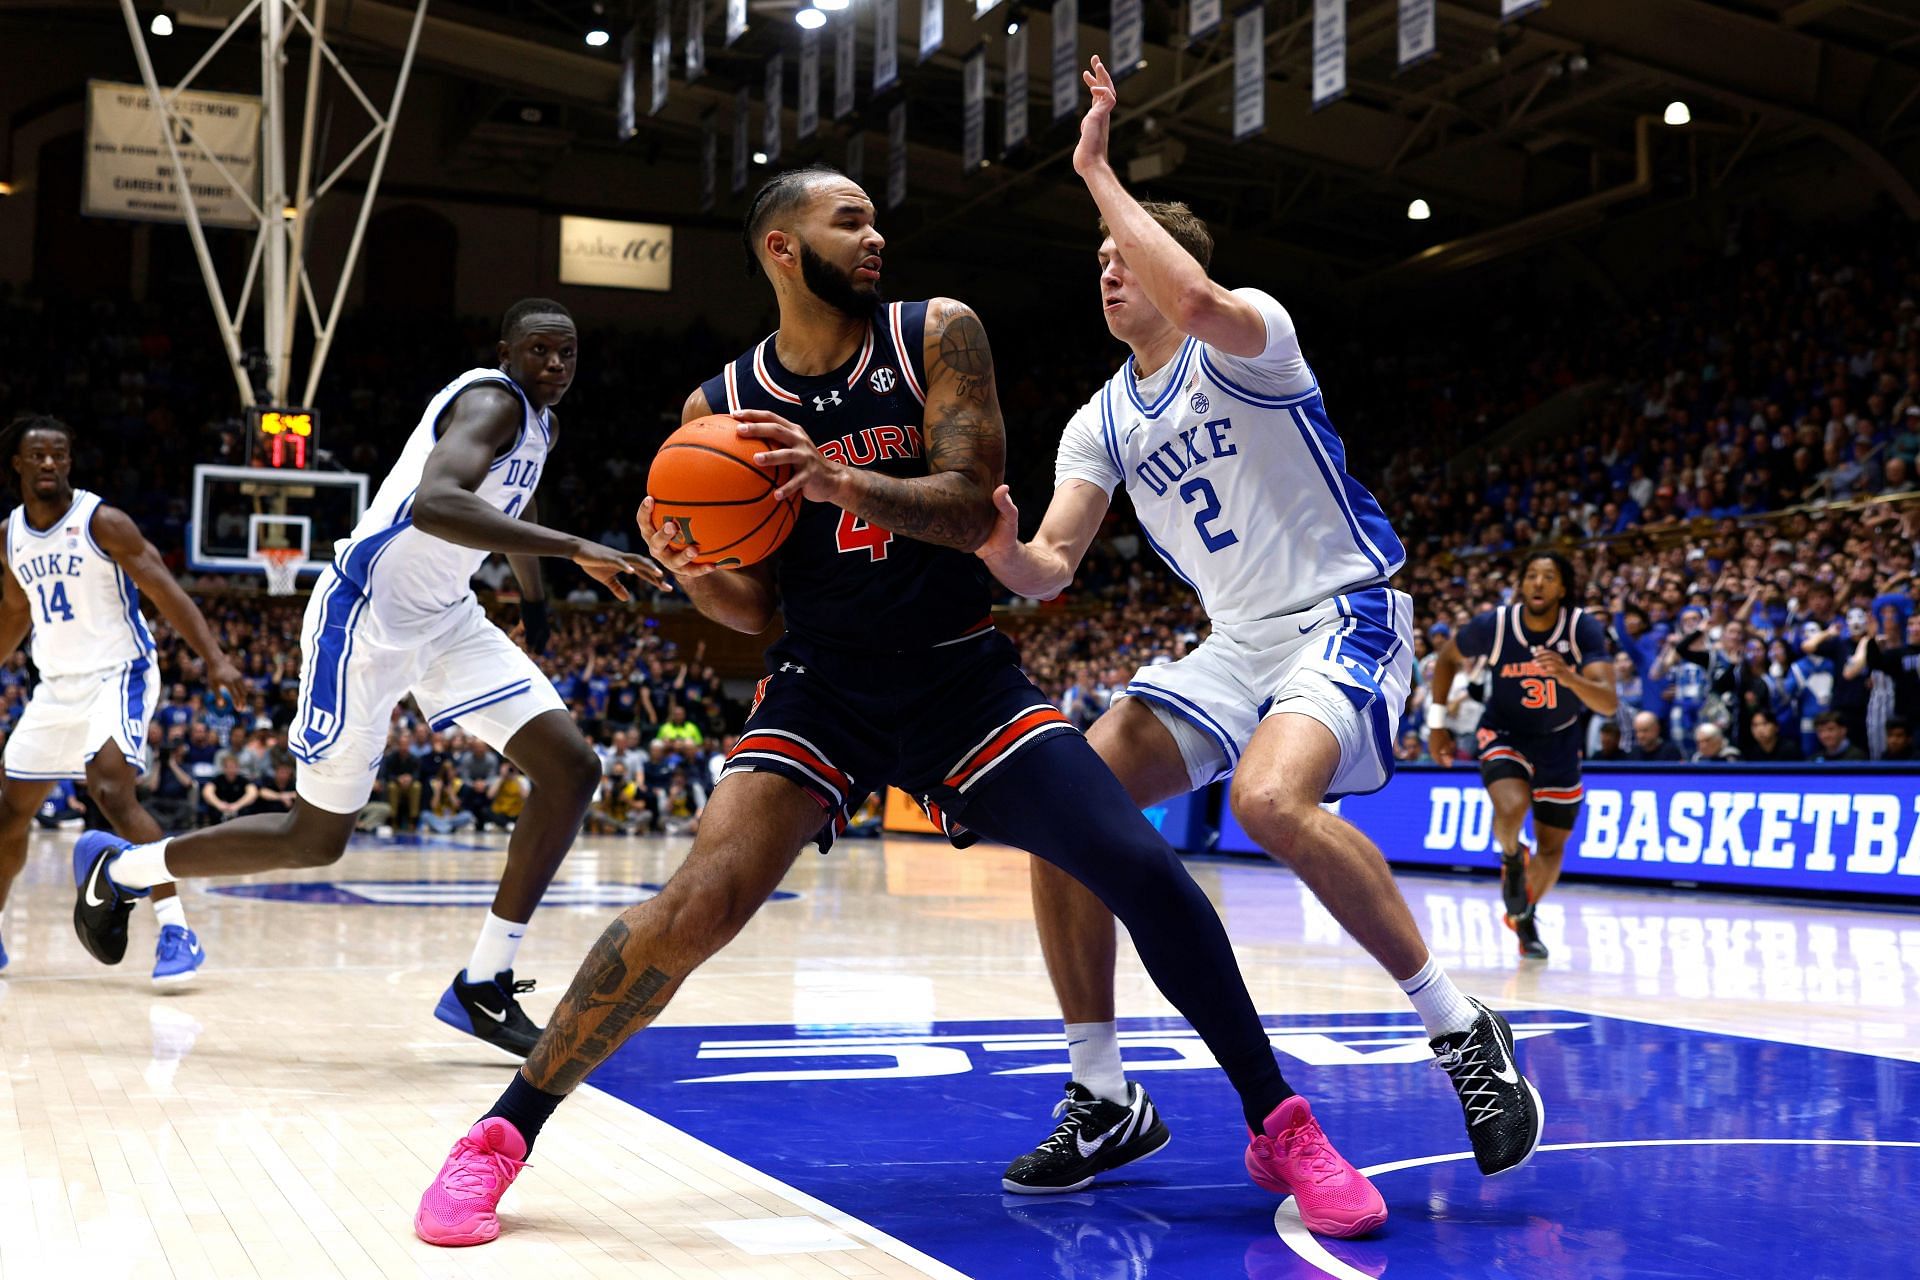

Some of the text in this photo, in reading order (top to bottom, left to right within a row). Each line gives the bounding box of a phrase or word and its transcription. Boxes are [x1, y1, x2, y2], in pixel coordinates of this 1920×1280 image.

[869, 367, 896, 393] SEC
[816, 425, 924, 466] BURN
[1136, 418, 1238, 497] DUKE
[835, 507, 894, 562] 4
[1179, 477, 1239, 553] 2
[18, 553, 83, 585] DUKE
[37, 581, 75, 623] 14
[1520, 678, 1558, 710] 31
[309, 706, 335, 736] D
[1424, 786, 1538, 855] DU
